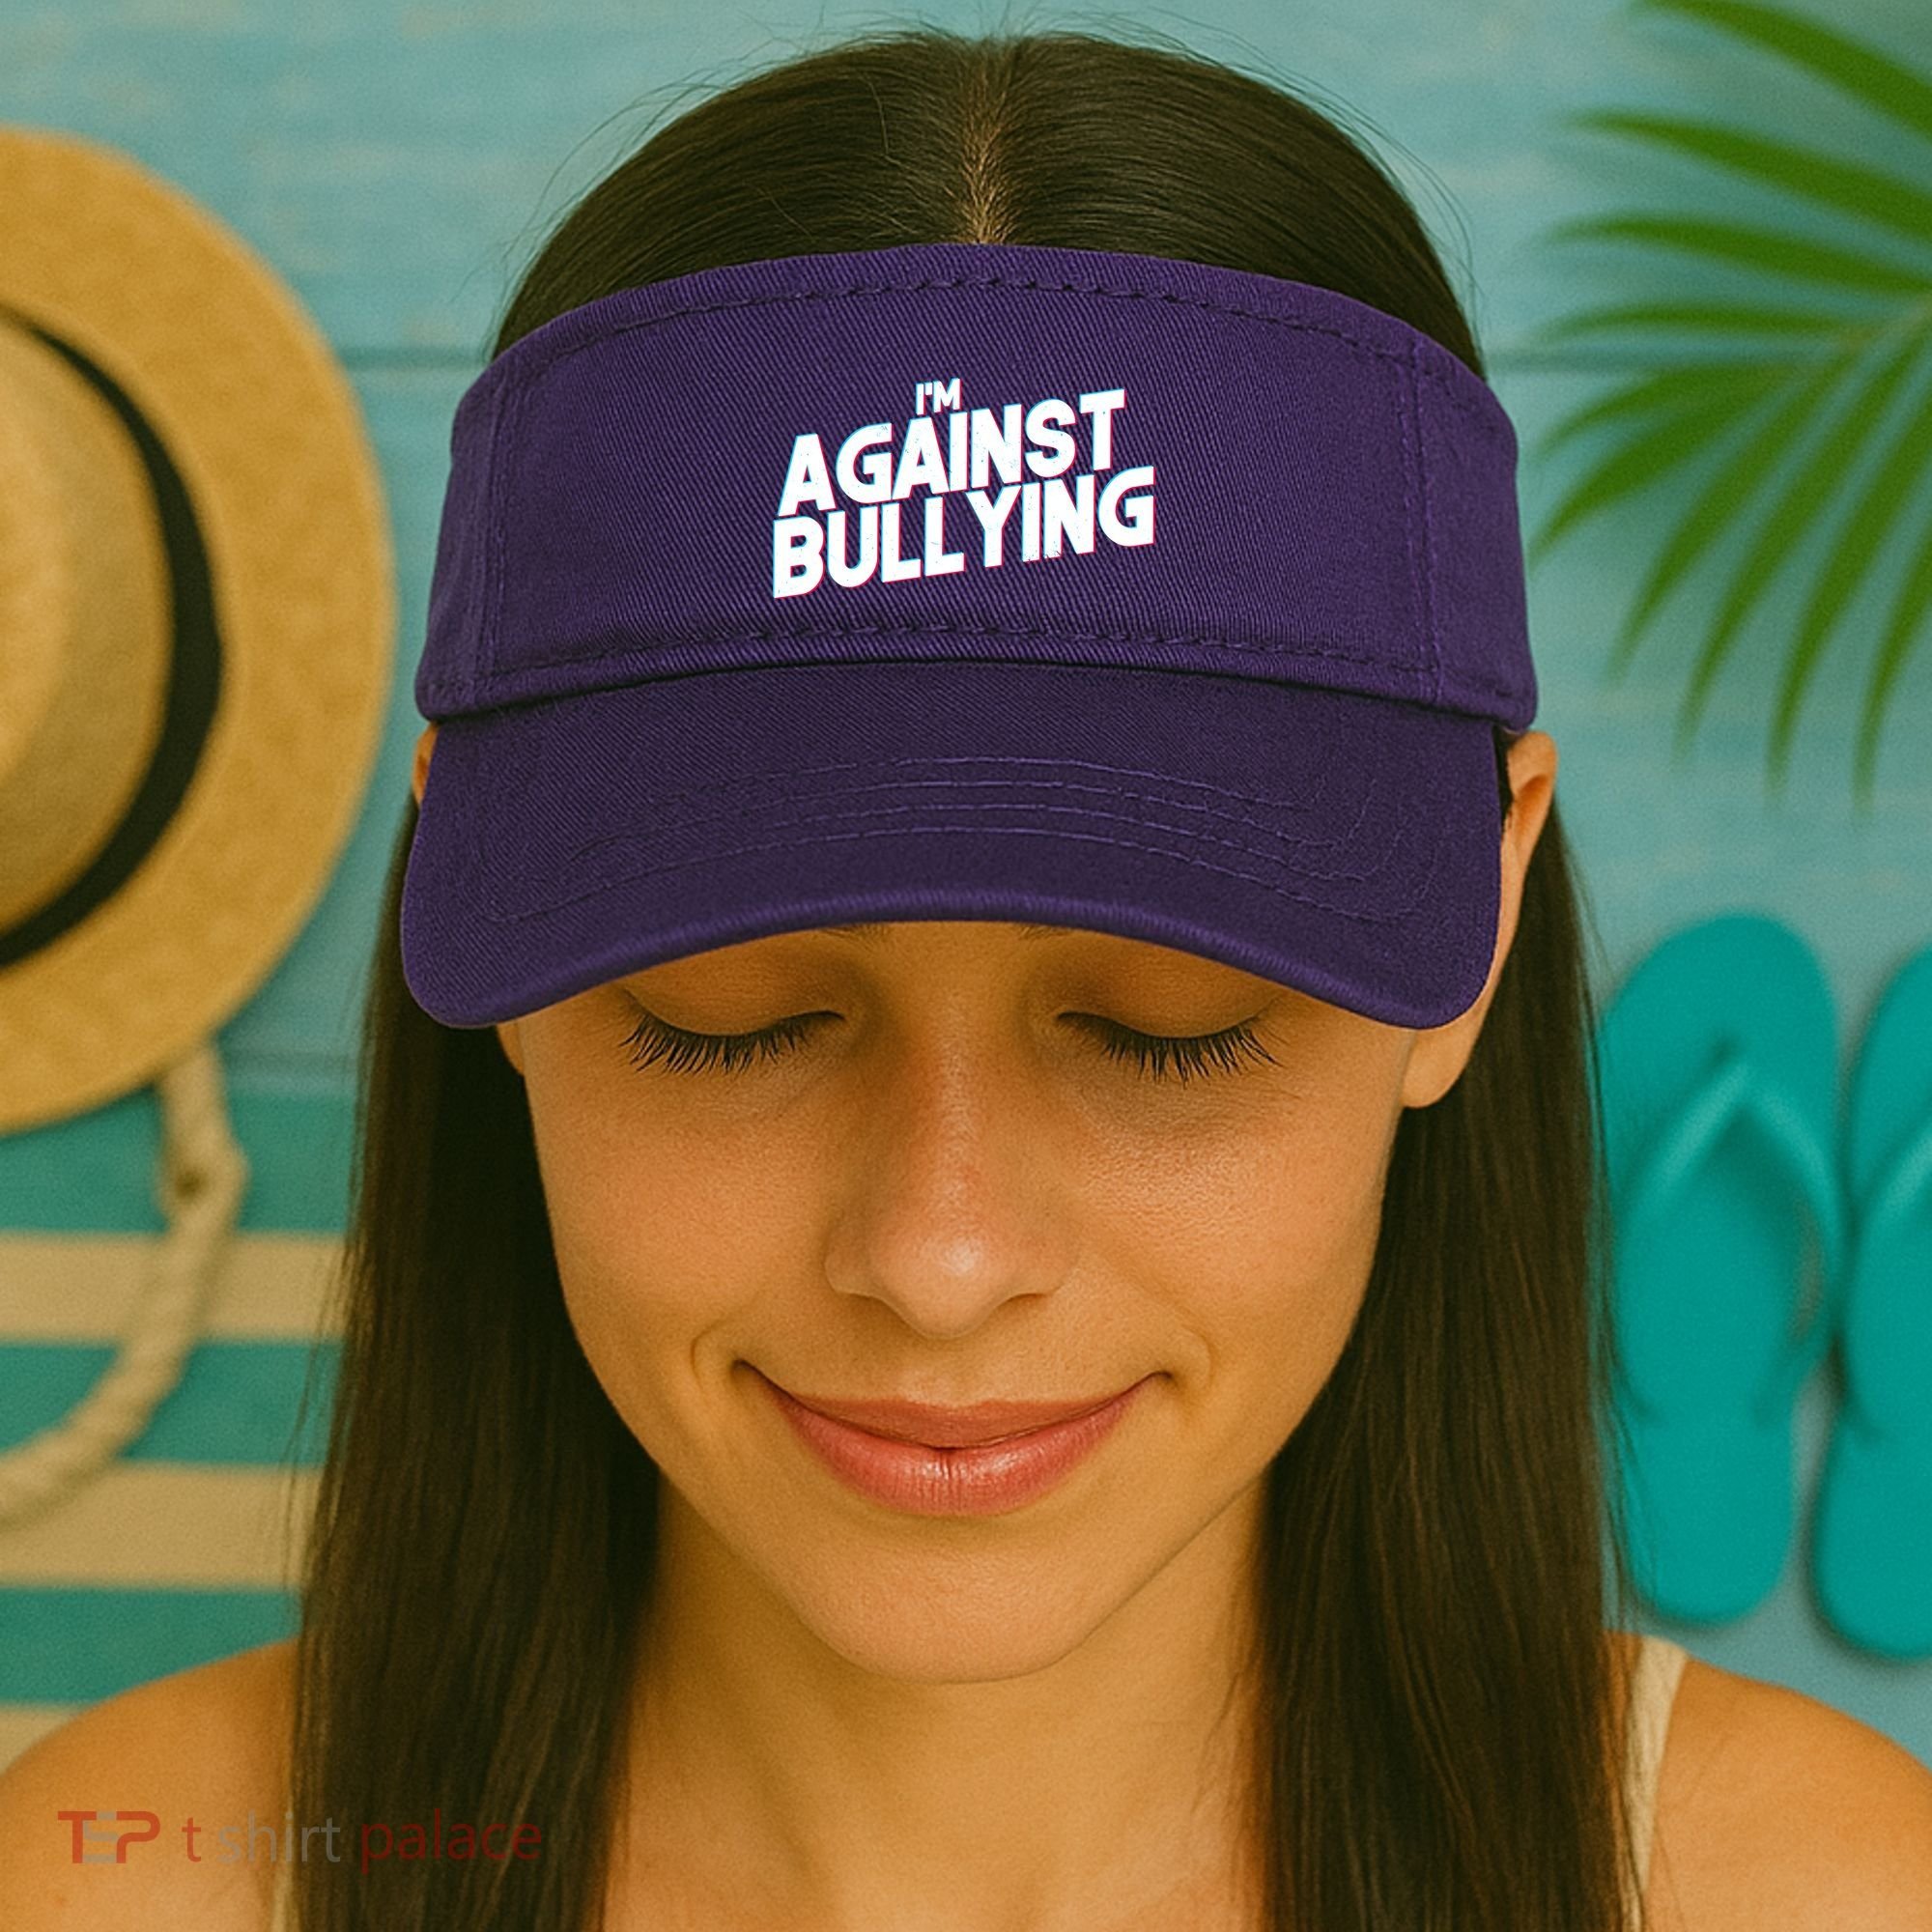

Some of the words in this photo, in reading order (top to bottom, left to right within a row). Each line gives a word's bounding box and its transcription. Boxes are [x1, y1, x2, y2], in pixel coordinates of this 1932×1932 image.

[778, 388, 1126, 517] AGAINST
[916, 378, 962, 415] I'M
[773, 465, 1155, 599] BULLYING
